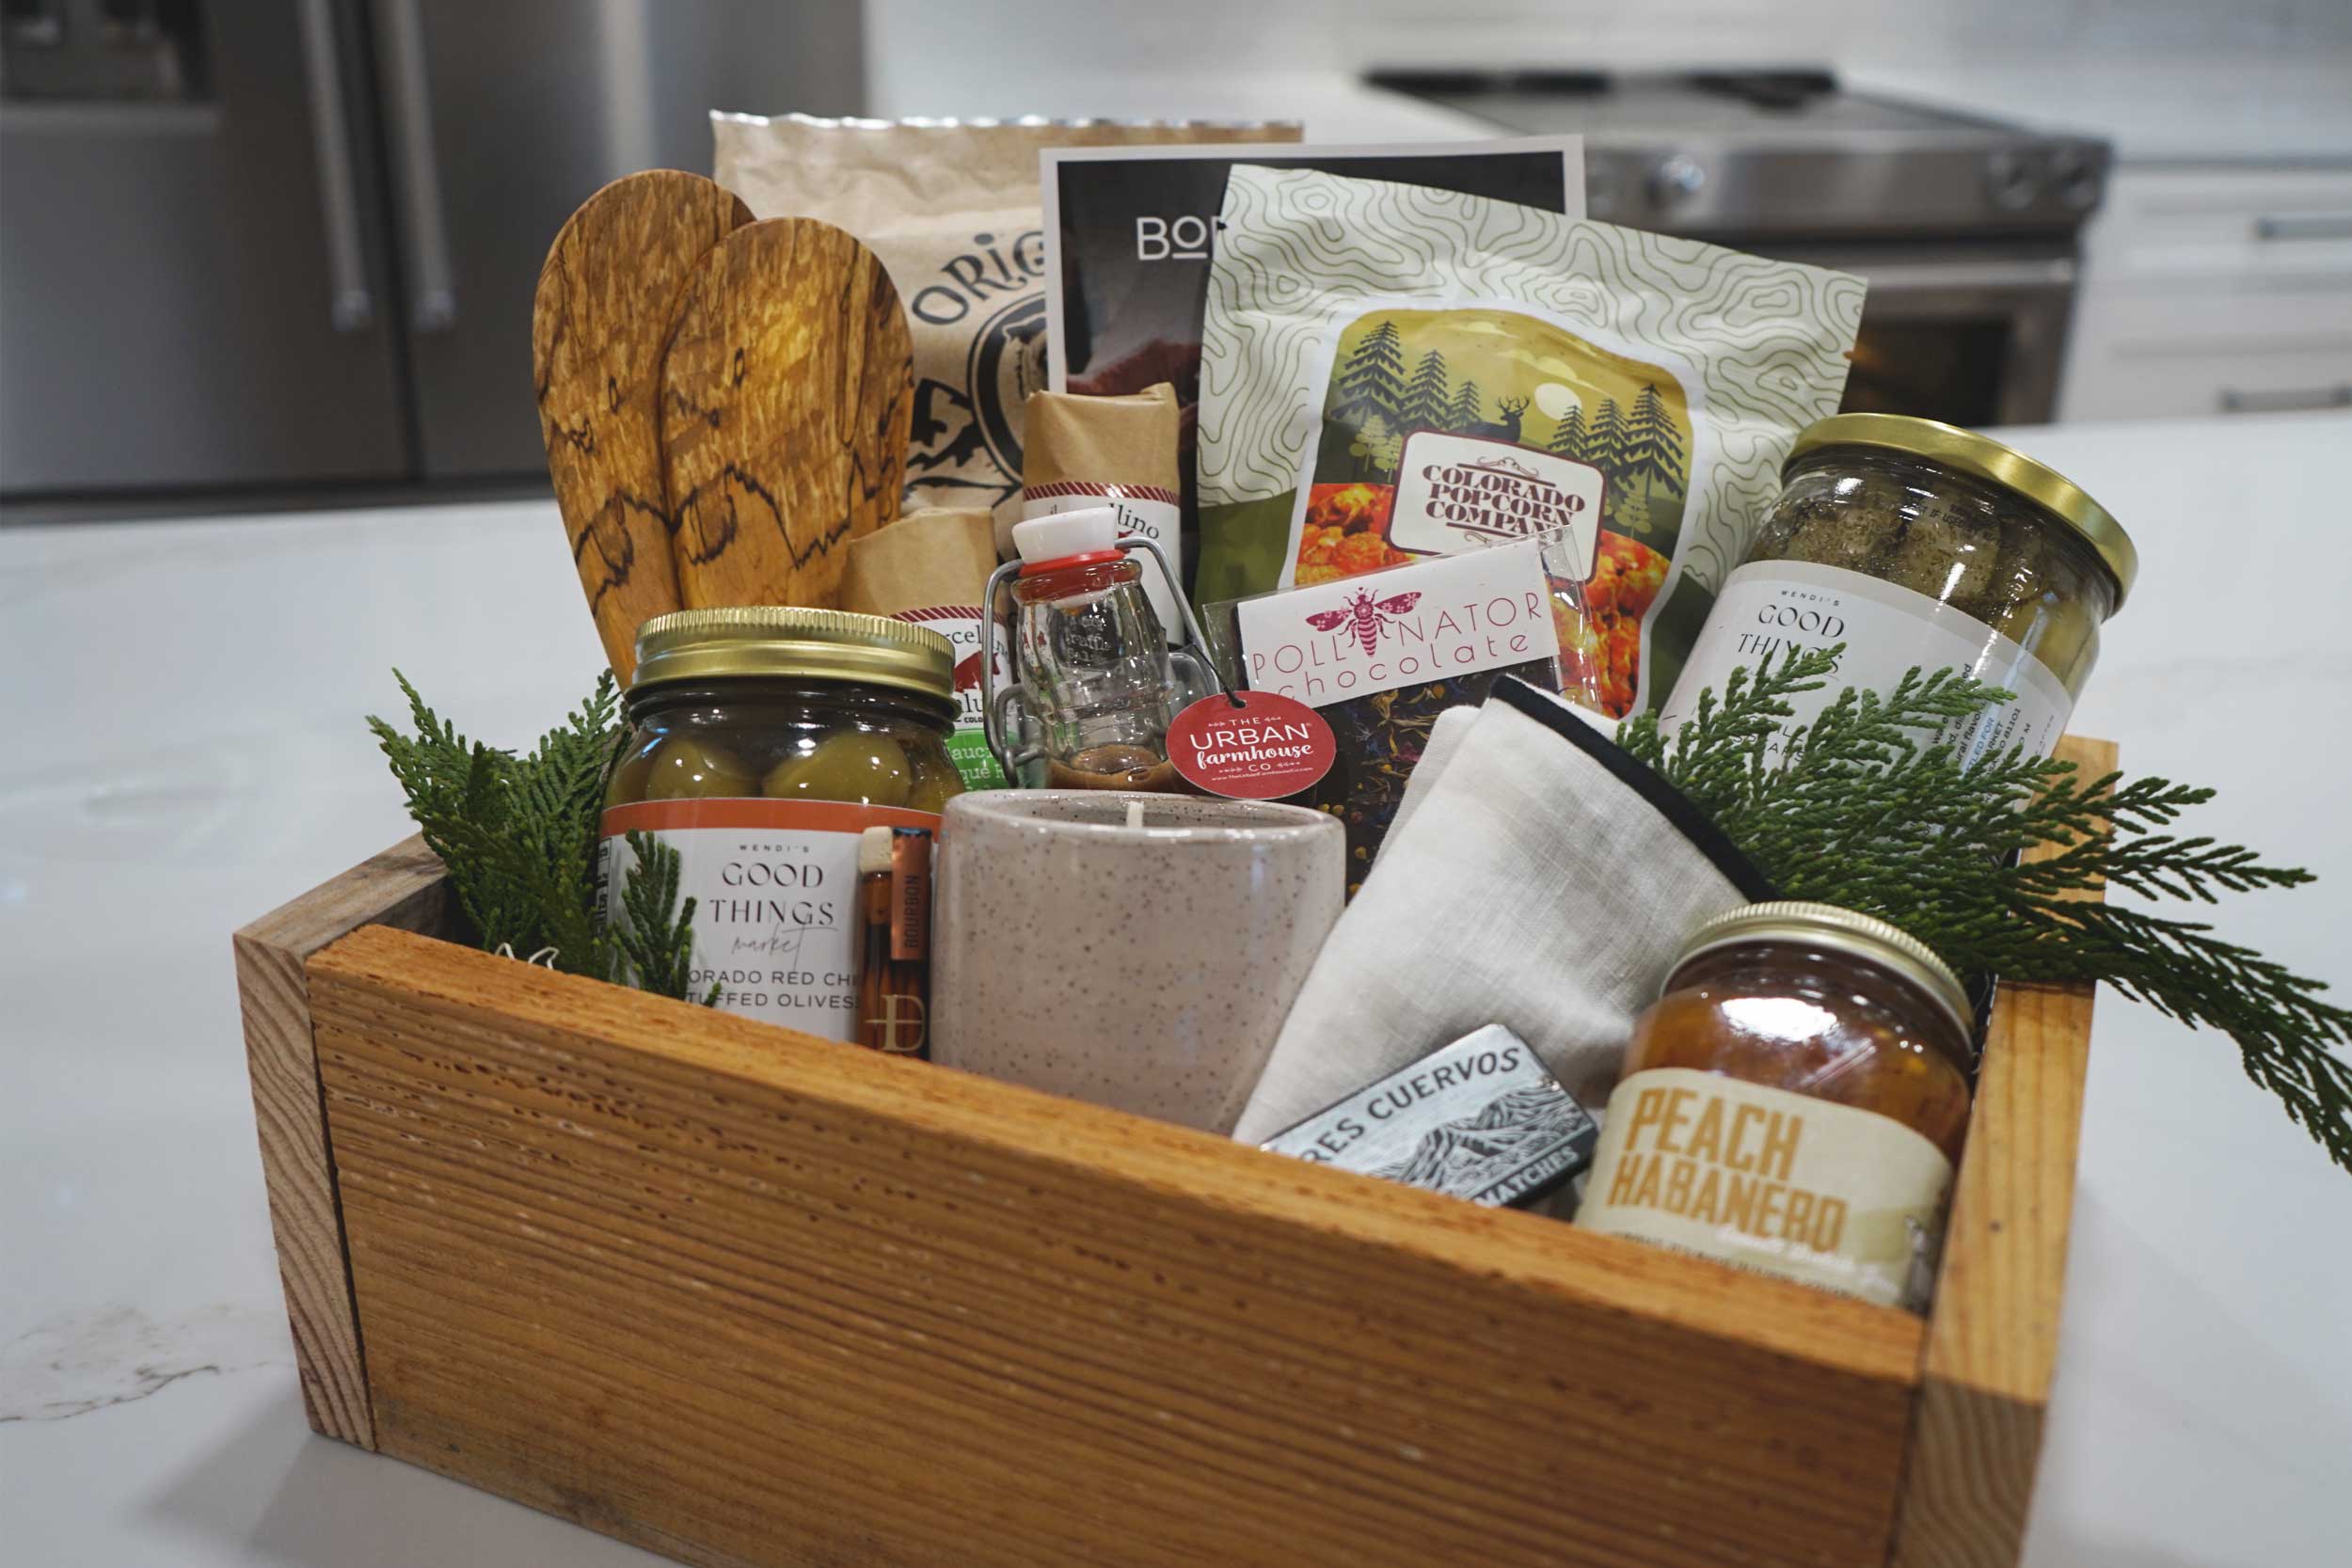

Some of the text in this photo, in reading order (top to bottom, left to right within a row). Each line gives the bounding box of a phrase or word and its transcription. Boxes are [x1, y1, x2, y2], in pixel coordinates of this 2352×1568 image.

[1422, 464, 1585, 513] COLORADO
[1428, 483, 1573, 526] POPCORN
[1781, 589, 1840, 607] WENDI'S
[1757, 604, 1845, 639] GOOD
[1278, 634, 1529, 702] chocolate
[1189, 722, 1310, 751] URBAN
[1228, 717, 1261, 727] THE
[1197, 743, 1314, 770] farmhouse
[1248, 762, 1272, 773] CO
[739, 844, 810, 853] WENDI'S
[722, 863, 824, 888] GOOD
[708, 898, 834, 926] THINGS
[730, 923, 838, 971] market
[771, 971, 815, 986] RED
[1367, 1046, 1521, 1120] CUERVOS
[1625, 1087, 1804, 1180] PEACH
[1607, 1155, 1849, 1253] HABANERO
